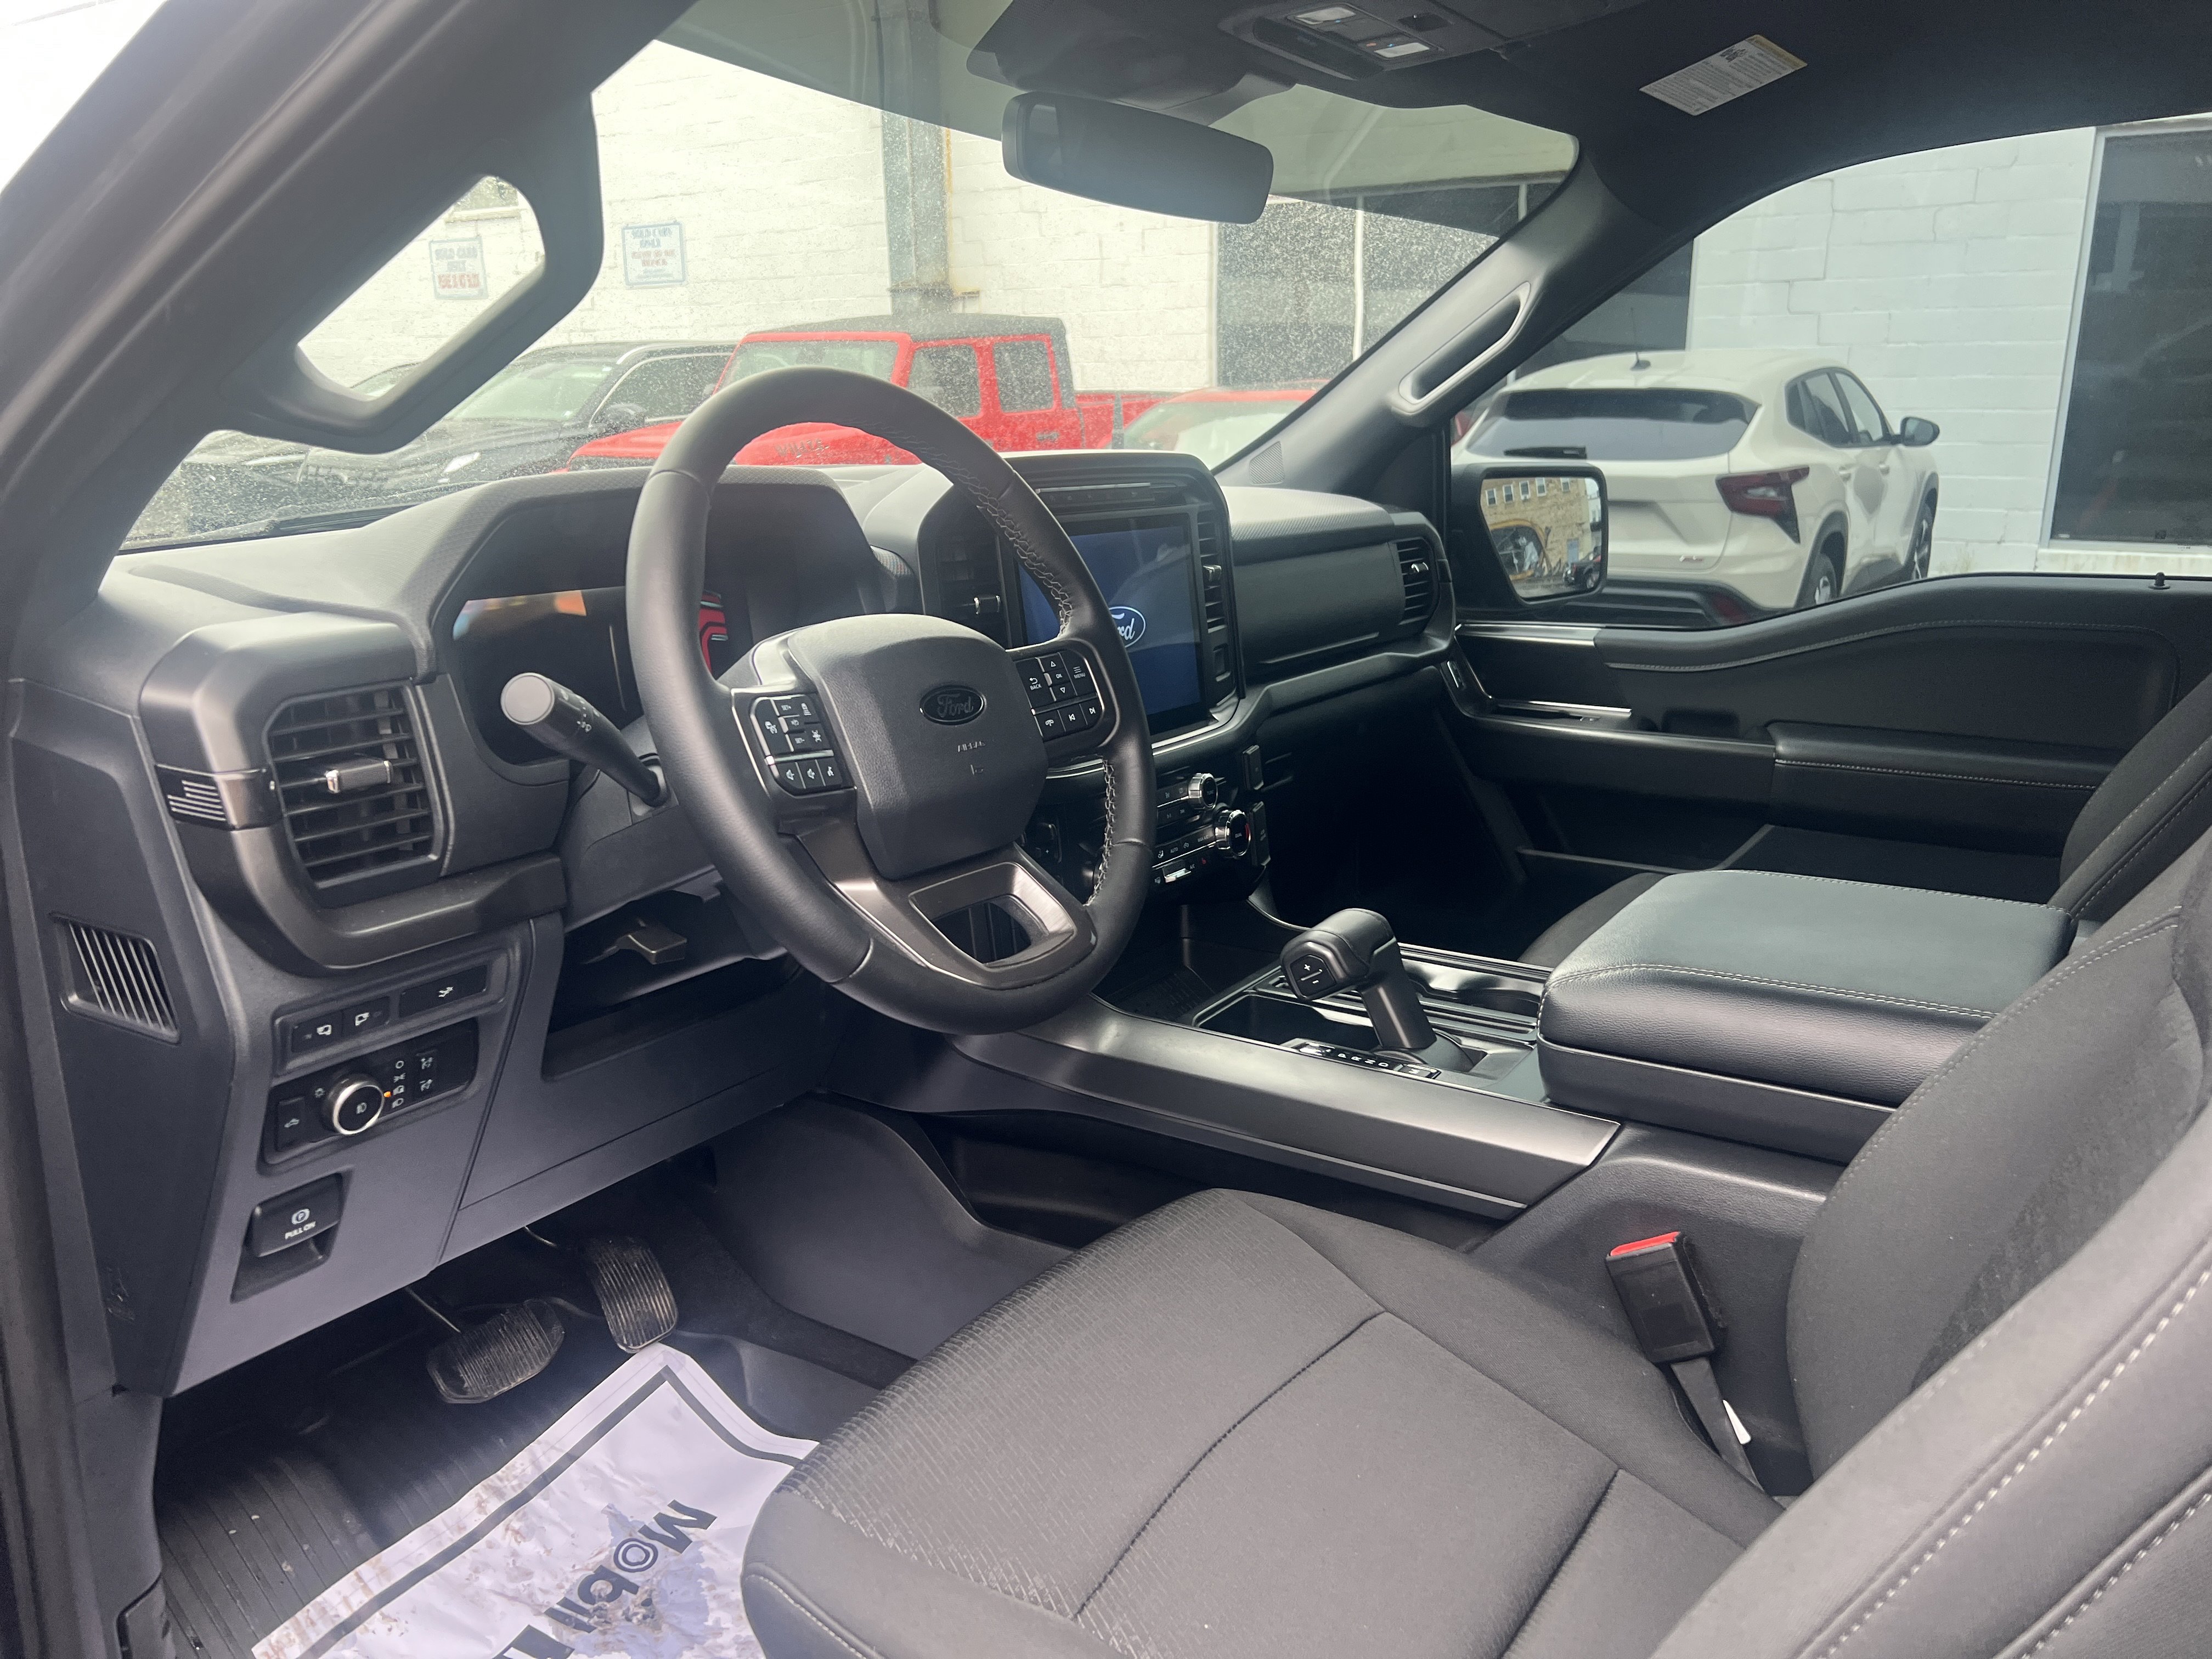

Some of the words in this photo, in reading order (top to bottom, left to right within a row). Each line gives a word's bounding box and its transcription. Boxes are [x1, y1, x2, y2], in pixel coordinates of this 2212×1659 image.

[1111, 613, 1135, 640] rd
[937, 692, 974, 718] Ford
[285, 1227, 303, 1239] PULL
[303, 1221, 316, 1231] ON
[544, 1499, 717, 1633] Mobil
